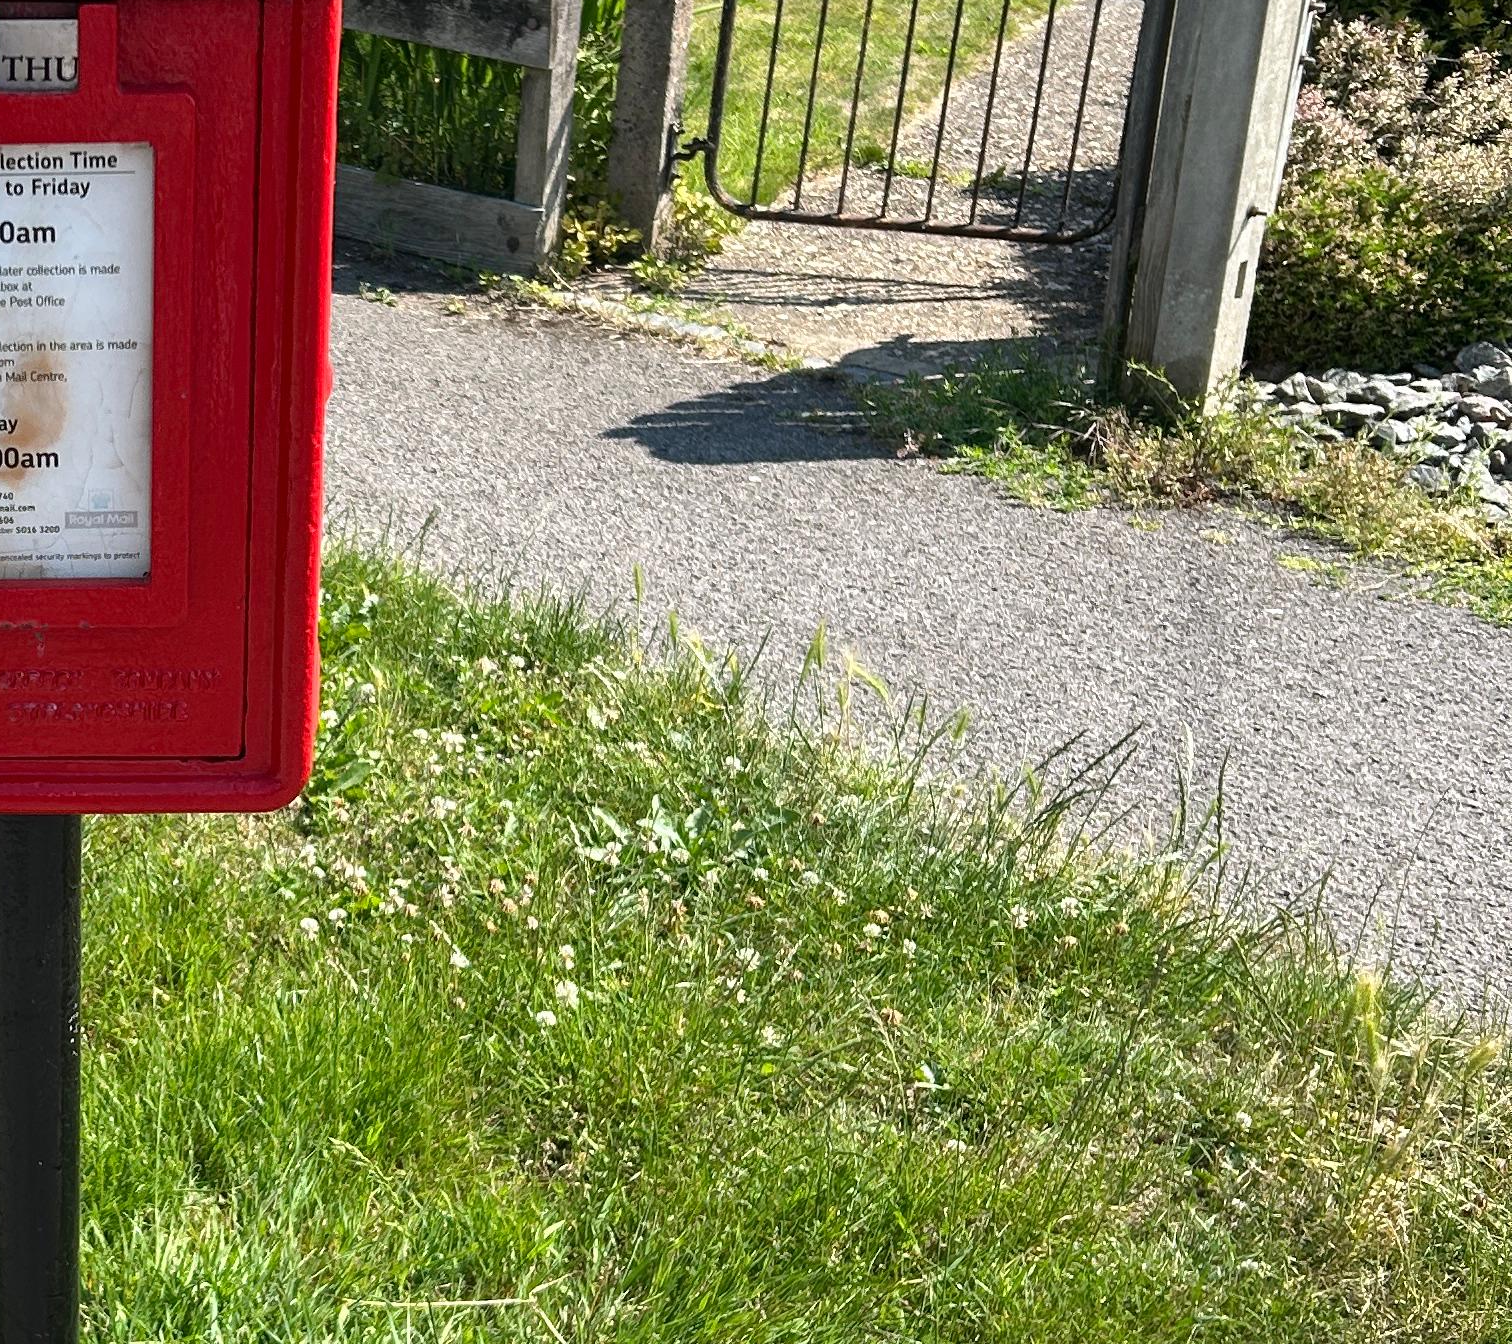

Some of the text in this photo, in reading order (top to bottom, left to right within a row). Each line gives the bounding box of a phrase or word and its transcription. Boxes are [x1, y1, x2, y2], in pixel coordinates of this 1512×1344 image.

[1, 55, 79, 82] THU
[69, 150, 118, 170] Time
[6, 179, 24, 196] to
[31, 177, 90, 198] Friday
[0, 265, 24, 277] later
[26, 264, 76, 277] collection
[78, 263, 88, 276] is
[90, 263, 121, 275] made
[21, 280, 33, 292] at
[9, 296, 33, 308] Post
[35, 295, 66, 307] Office
[37, 341, 46, 352] in
[49, 339, 67, 352] the
[69, 341, 93, 351] area
[95, 339, 105, 351] is
[107, 338, 138, 351] made
[5, 371, 27, 383] Mail
[29, 371, 68, 384] Centre,
[68, 512, 135, 527] Royal Mail
[66, 552, 102, 561] markings
[103, 552, 112, 560] to
